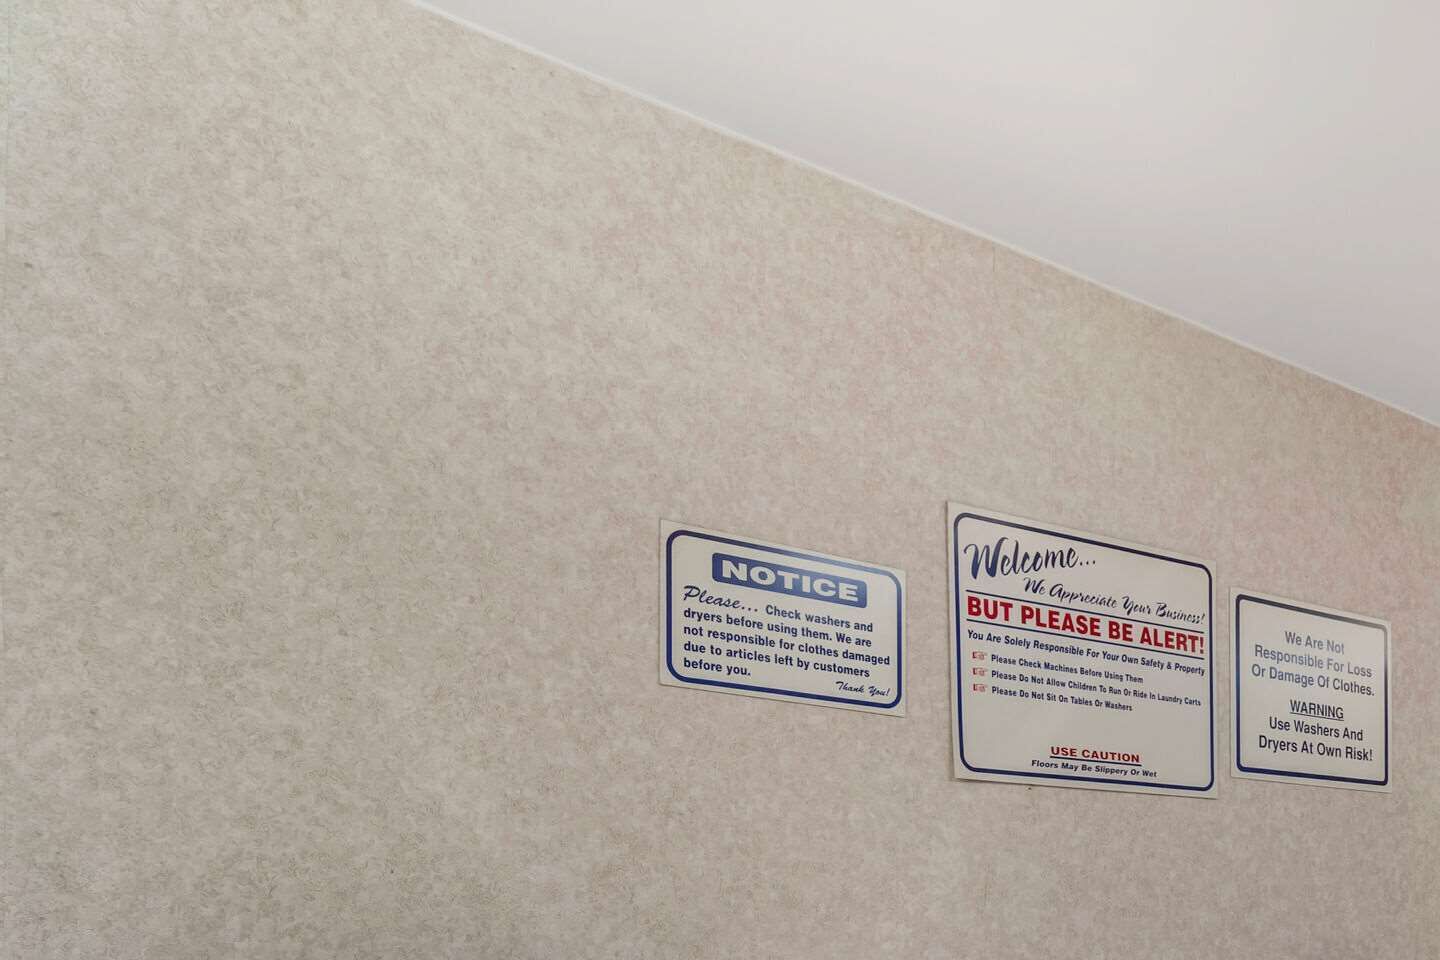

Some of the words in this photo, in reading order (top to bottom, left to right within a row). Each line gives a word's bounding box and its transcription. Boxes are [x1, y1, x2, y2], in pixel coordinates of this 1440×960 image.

[963, 536, 1097, 580] Welcome...
[722, 559, 859, 602] NOTICE
[683, 585, 758, 613] Please...
[765, 604, 802, 621] Check
[804, 613, 851, 629] washers
[853, 622, 874, 633] and
[1023, 577, 1046, 595] We
[1048, 583, 1117, 609] Appreciate
[1121, 595, 1151, 616] Your
[1155, 602, 1206, 625] Business!
[683, 607, 723, 624] dryers
[725, 613, 764, 630] before
[767, 623, 798, 638] using
[801, 627, 833, 641] them.
[835, 631, 852, 644] We
[854, 637, 872, 648] are
[967, 595, 1014, 622] BUT
[1020, 604, 1102, 637] PLEASE
[1108, 620, 1134, 643] BE
[1139, 626, 1204, 655] ALERT!
[683, 626, 704, 637] not
[707, 629, 776, 648] responsible
[779, 638, 795, 651] for
[798, 643, 839, 658] clothes
[841, 649, 890, 666] damaged
[683, 641, 706, 654] due
[709, 644, 723, 656] to
[725, 648, 771, 663] articles
[774, 654, 794, 667] left
[796, 657, 811, 671] by
[813, 662, 870, 678] customers
[967, 628, 984, 641] You
[985, 632, 1002, 644] Are
[1003, 634, 1032, 650] Solely
[1032, 639, 1085, 657] Responsible
[1086, 648, 1100, 658] For
[1101, 650, 1120, 662] Your
[1121, 653, 1139, 665] Own
[1140, 656, 1165, 671] Safety
[1174, 662, 1205, 677] Property
[1284, 630, 1302, 646] We
[1304, 634, 1324, 651] Are
[1326, 639, 1345, 655] Not
[683, 657, 723, 673] before
[726, 665, 751, 676] you.
[991, 653, 1017, 666] Please
[1018, 657, 1042, 670] Check
[1043, 661, 1079, 675] Machines
[1079, 666, 1103, 678] Before
[1103, 670, 1124, 683] Using
[1124, 673, 1144, 684] Them
[1254, 643, 1324, 669] Responsible
[1326, 657, 1345, 673] For
[1347, 661, 1373, 678] Loss
[835, 680, 865, 694] Thank
[867, 685, 891, 697] You!
[991, 669, 1017, 681] Please
[1018, 673, 1029, 683] Do
[1031, 675, 1044, 685] Not
[1045, 677, 1066, 688] Allow
[1067, 680, 1098, 692] Children
[1098, 684, 1107, 694] To
[1108, 685, 1122, 695] Run
[1123, 688, 1132, 697] Or
[1132, 689, 1148, 699] Ride
[1149, 691, 1156, 700] In
[1157, 692, 1183, 705] Laundry
[1184, 696, 1202, 707] Carts
[1251, 663, 1267, 678] Or
[1269, 666, 1315, 689] Damage
[1317, 674, 1330, 689] Of
[1332, 677, 1375, 697] Clothes.
[991, 685, 1017, 697] Please
[1019, 689, 1030, 699] Do
[1031, 690, 1045, 701] Not
[1046, 692, 1057, 702] Sit
[1058, 694, 1069, 703] On
[1070, 695, 1093, 707] Tables
[1094, 698, 1104, 708] Or
[1104, 700, 1133, 712] Washers
[1289, 699, 1344, 720] WARNING
[1269, 715, 1291, 732] Use
[1293, 719, 1340, 739] Washers
[1342, 727, 1364, 742] And
[1050, 746, 1078, 758] USE
[1081, 749, 1140, 764] CAUTION
[1258, 734, 1298, 754] Dryers
[1300, 740, 1314, 755] At
[1316, 742, 1342, 758] Own
[1345, 745, 1373, 762] Risk!
[1031, 759, 1059, 769] Floors
[1061, 762, 1079, 772] May
[1081, 763, 1093, 772] Be
[1094, 764, 1129, 777] Slippery
[1130, 768, 1141, 776] Or
[1142, 769, 1157, 778] Wet
